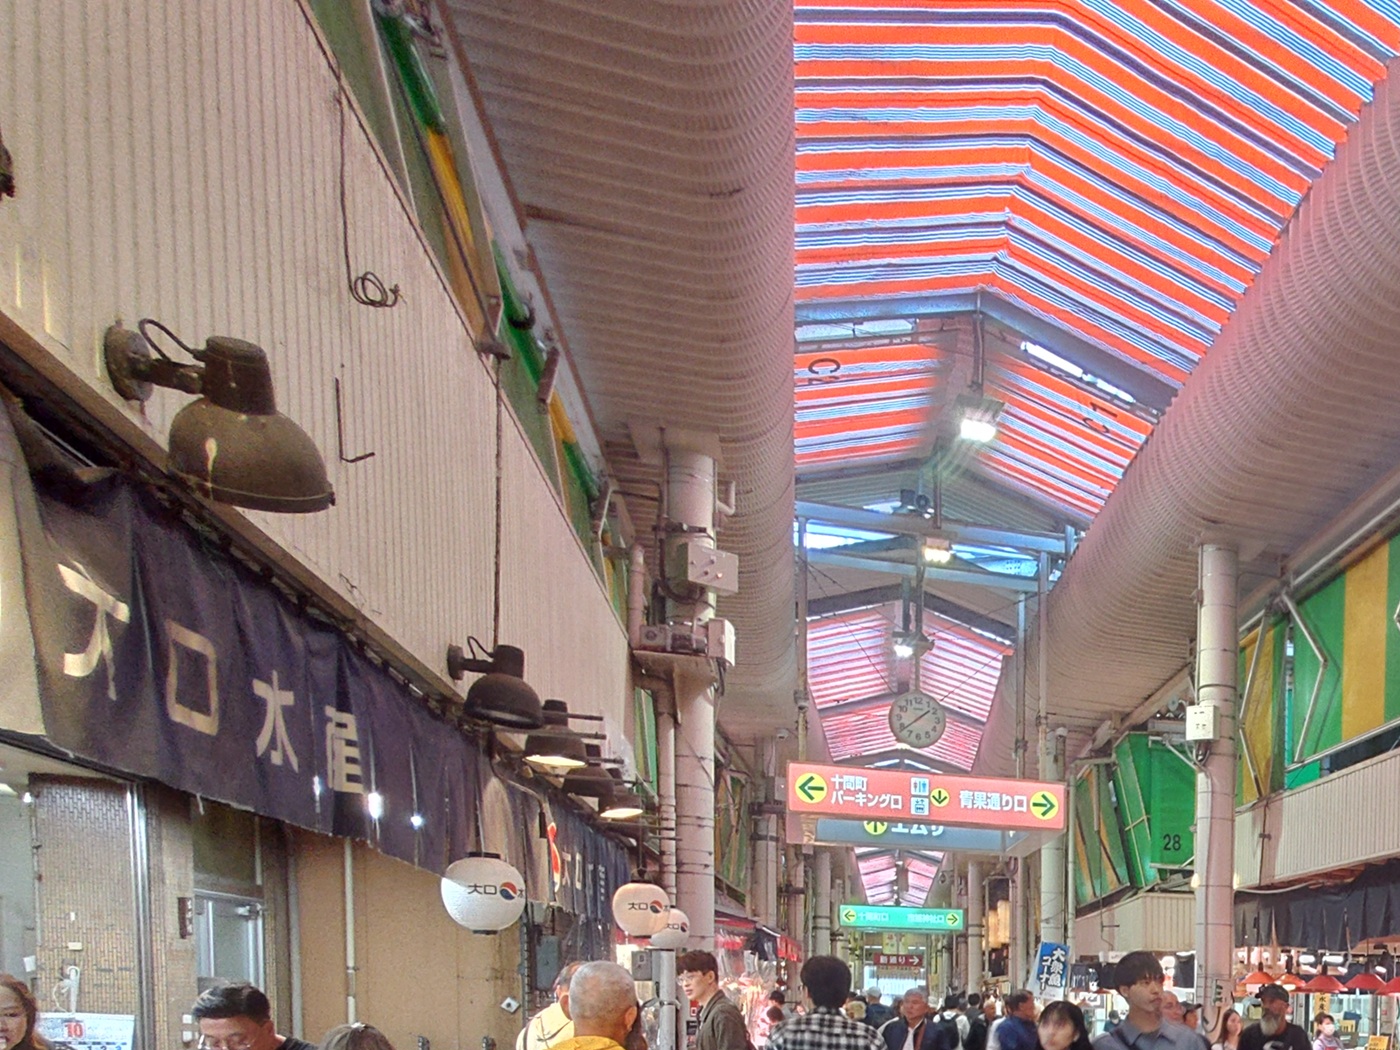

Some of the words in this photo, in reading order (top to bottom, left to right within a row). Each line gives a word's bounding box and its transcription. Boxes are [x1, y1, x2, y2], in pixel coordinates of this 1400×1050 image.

[831, 775, 868, 792] 十間町
[958, 789, 1028, 813] 青果通り口
[1163, 834, 1182, 851] 28
[64, 1021, 84, 1038] 10
